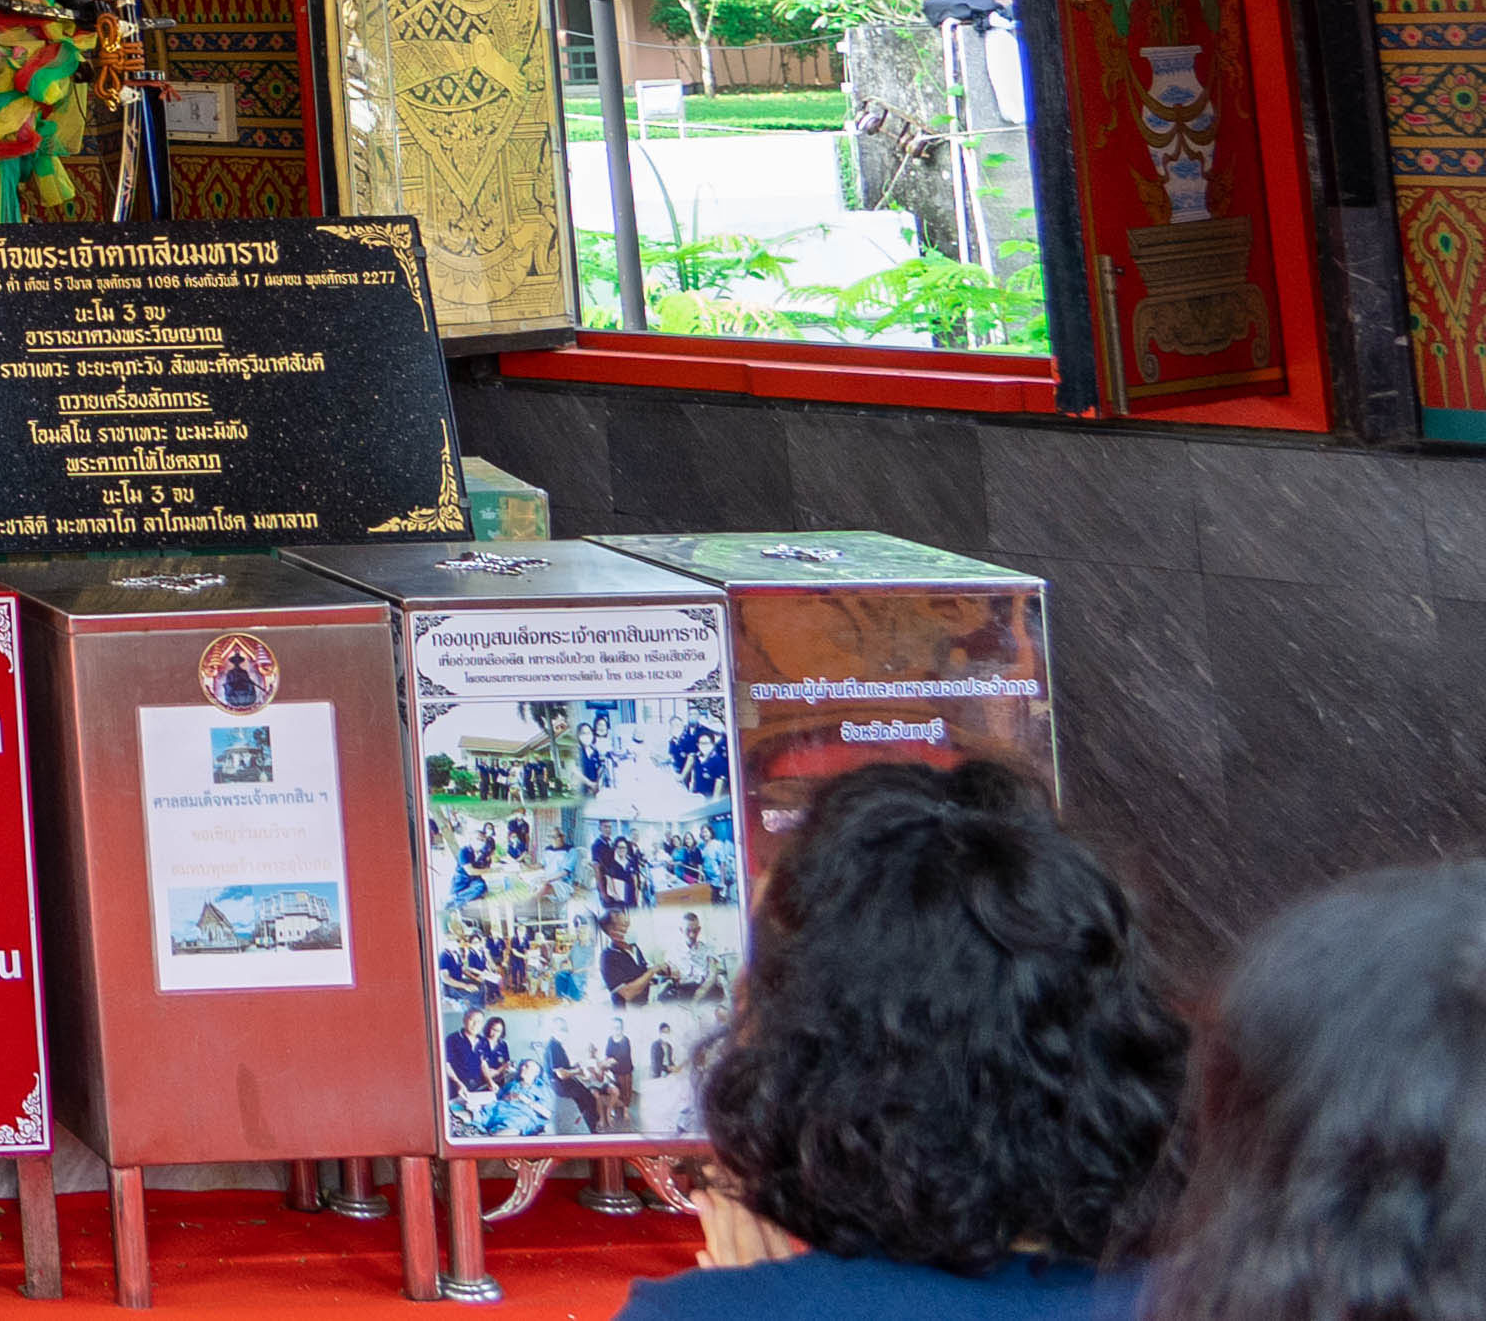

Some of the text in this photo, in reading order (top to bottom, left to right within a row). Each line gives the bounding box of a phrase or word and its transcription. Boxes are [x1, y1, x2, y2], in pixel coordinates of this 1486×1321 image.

[53, 277, 62, 291] 5
[146, 274, 180, 289] 1096
[244, 273, 260, 288] 17
[362, 270, 397, 285] 2277
[74, 299, 167, 322] นะโม 3 จบ
[25, 324, 223, 346] อาราธนาดวงพระวิญญาณ
[0, 361, 70, 379] ราชาเทวะ
[58, 385, 210, 411] ถวายเครื่องสักการะ
[28, 419, 92, 444] โอมสิโน
[97, 424, 168, 443] ราชาเทวะ
[66, 447, 222, 472] พระคาถาให้โชคลาภ
[102, 479, 195, 505] นะโม 3 จบ
[432, 625, 710, 651] กองบุญสมเด็จพระเจ้าตากสินมหาราช
[841, 716, 946, 745] จังหวัดจันทบุรี
[153, 787, 315, 811] ศาลสมเด็จพระเจ้าตากสิน
